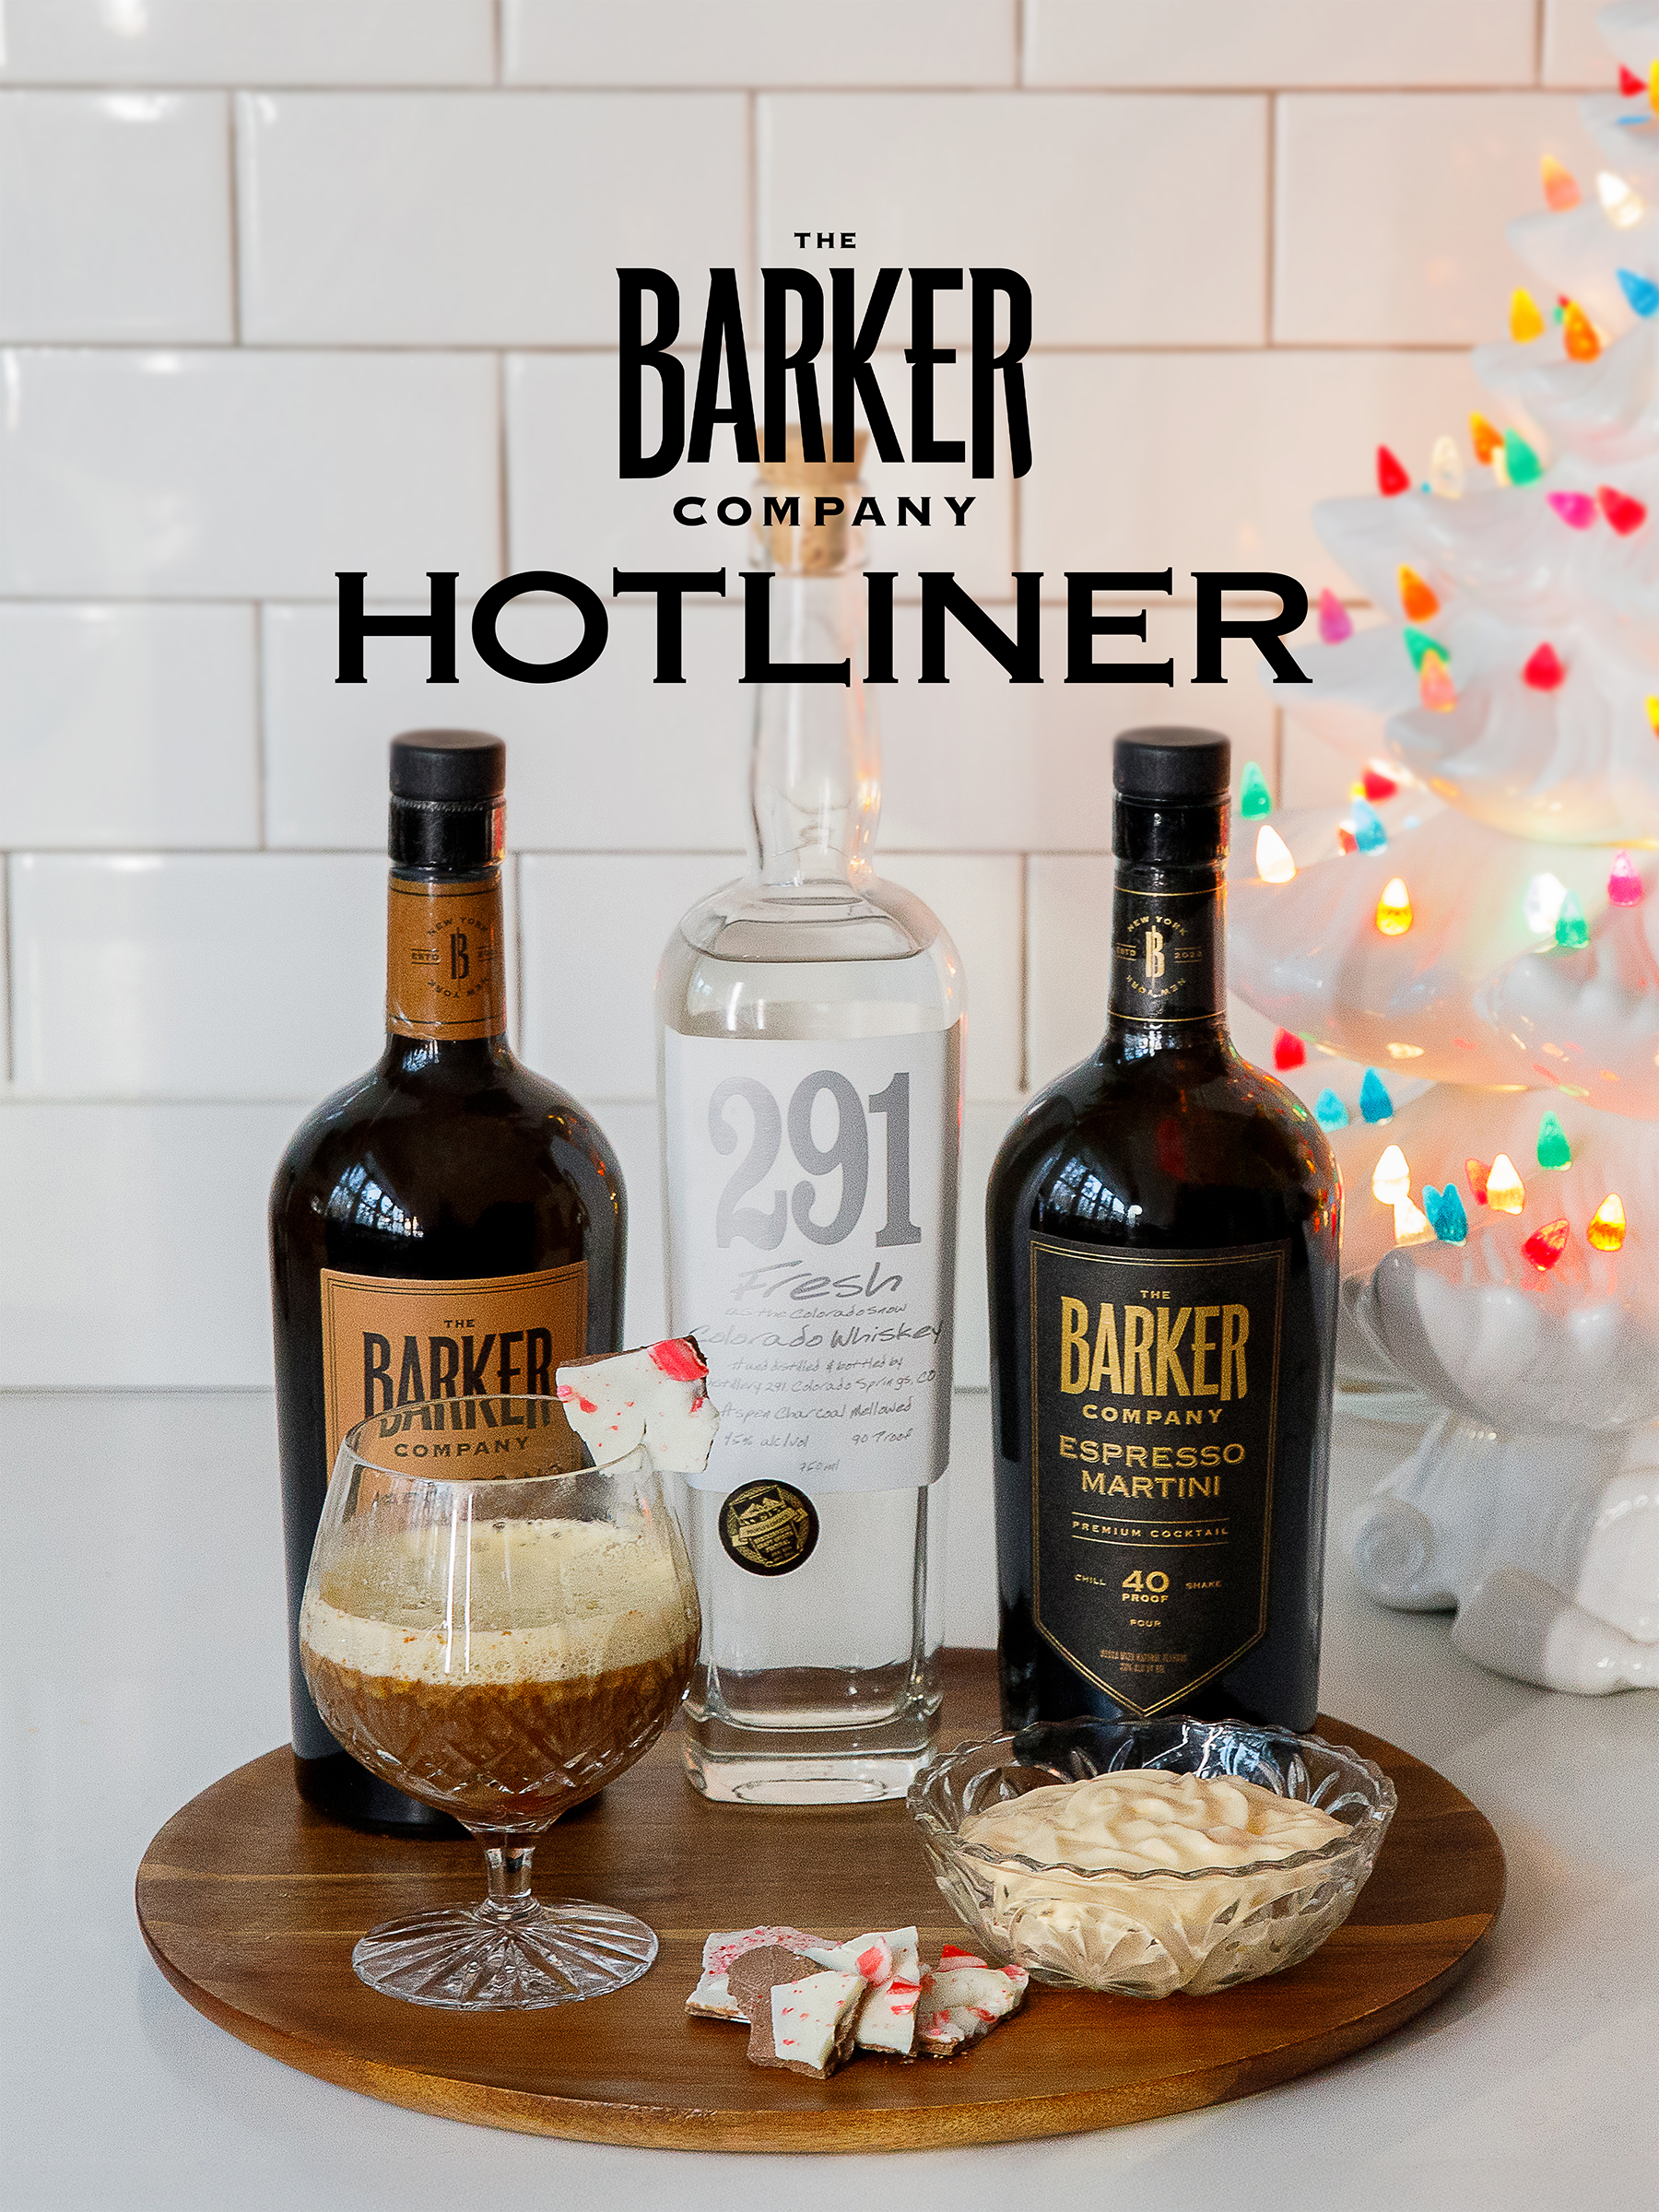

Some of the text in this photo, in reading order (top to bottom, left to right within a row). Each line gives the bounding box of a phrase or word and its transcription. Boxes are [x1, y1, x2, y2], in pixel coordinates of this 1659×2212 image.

[1127, 915, 1188, 935] NEW YORK
[708, 1069, 922, 1251] 291
[730, 1260, 904, 1300] Fresh
[1139, 1289, 1171, 1300] THE
[443, 1318, 476, 1328] THE
[689, 1318, 945, 1348] Colorado Whiskey
[1060, 1295, 1250, 1402] BARKER
[362, 1326, 553, 1438] BARKER
[916, 1369, 936, 1383] CO
[774, 1405, 847, 1420] Charcoal
[1081, 1403, 1223, 1426] COMPANY
[394, 1436, 530, 1459] COMPANY
[1060, 1434, 1246, 1469] ESPRESSO
[1081, 1469, 1221, 1500] MARTINI
[1071, 1521, 1230, 1538] PREMIUM COCKTAIL
[1075, 1573, 1107, 1586] CHILL
[1122, 1570, 1171, 1593] 40
[1185, 1580, 1222, 1590] SHAKE
[1122, 1593, 1169, 1604] PROOF
[1129, 1618, 1162, 1628] POUR
